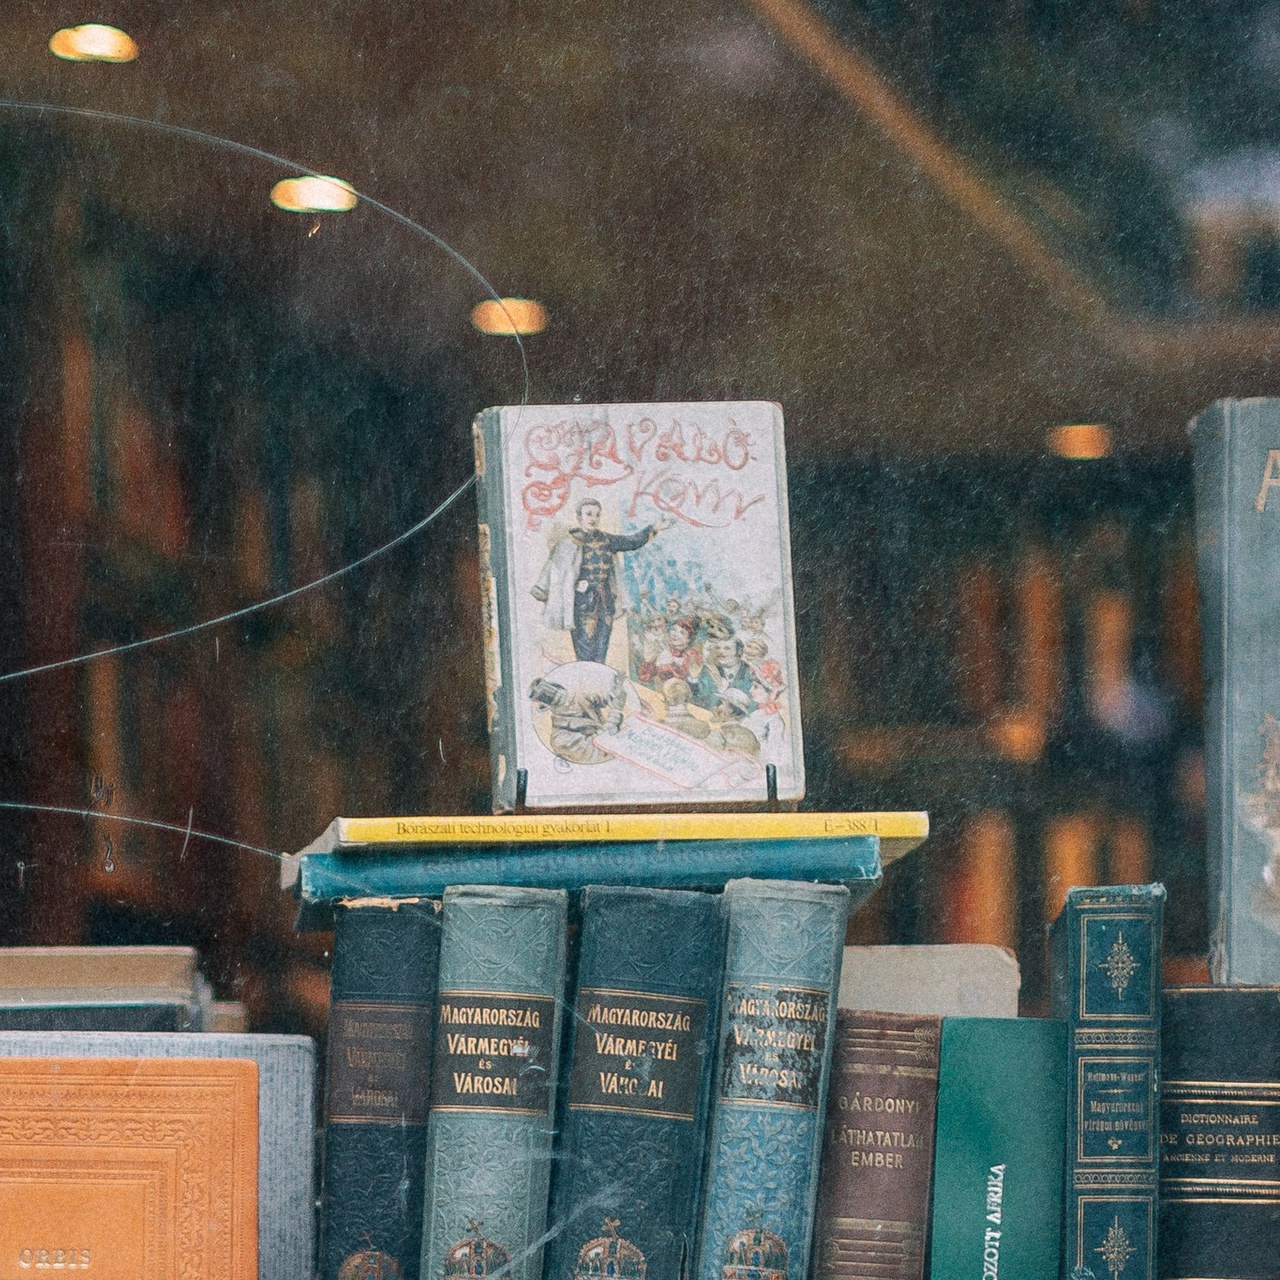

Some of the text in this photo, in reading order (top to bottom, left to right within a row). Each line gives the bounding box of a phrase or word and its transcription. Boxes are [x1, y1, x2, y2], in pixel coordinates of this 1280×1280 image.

[439, 1004, 541, 1028] MAGYARORSZÁG
[587, 1003, 691, 1032] MAGYARORSZÁG
[453, 1072, 518, 1096] VÁROSAI
[838, 1091, 920, 1114] GÁRDONYI
[1180, 1113, 1260, 1125] DICTIONNAIRE
[851, 1151, 903, 1169] EMBER
[1231, 1153, 1277, 1164] MODERNE
[986, 1163, 1007, 1225] AFRIKA
[19, 1248, 91, 1269] ORBIS
